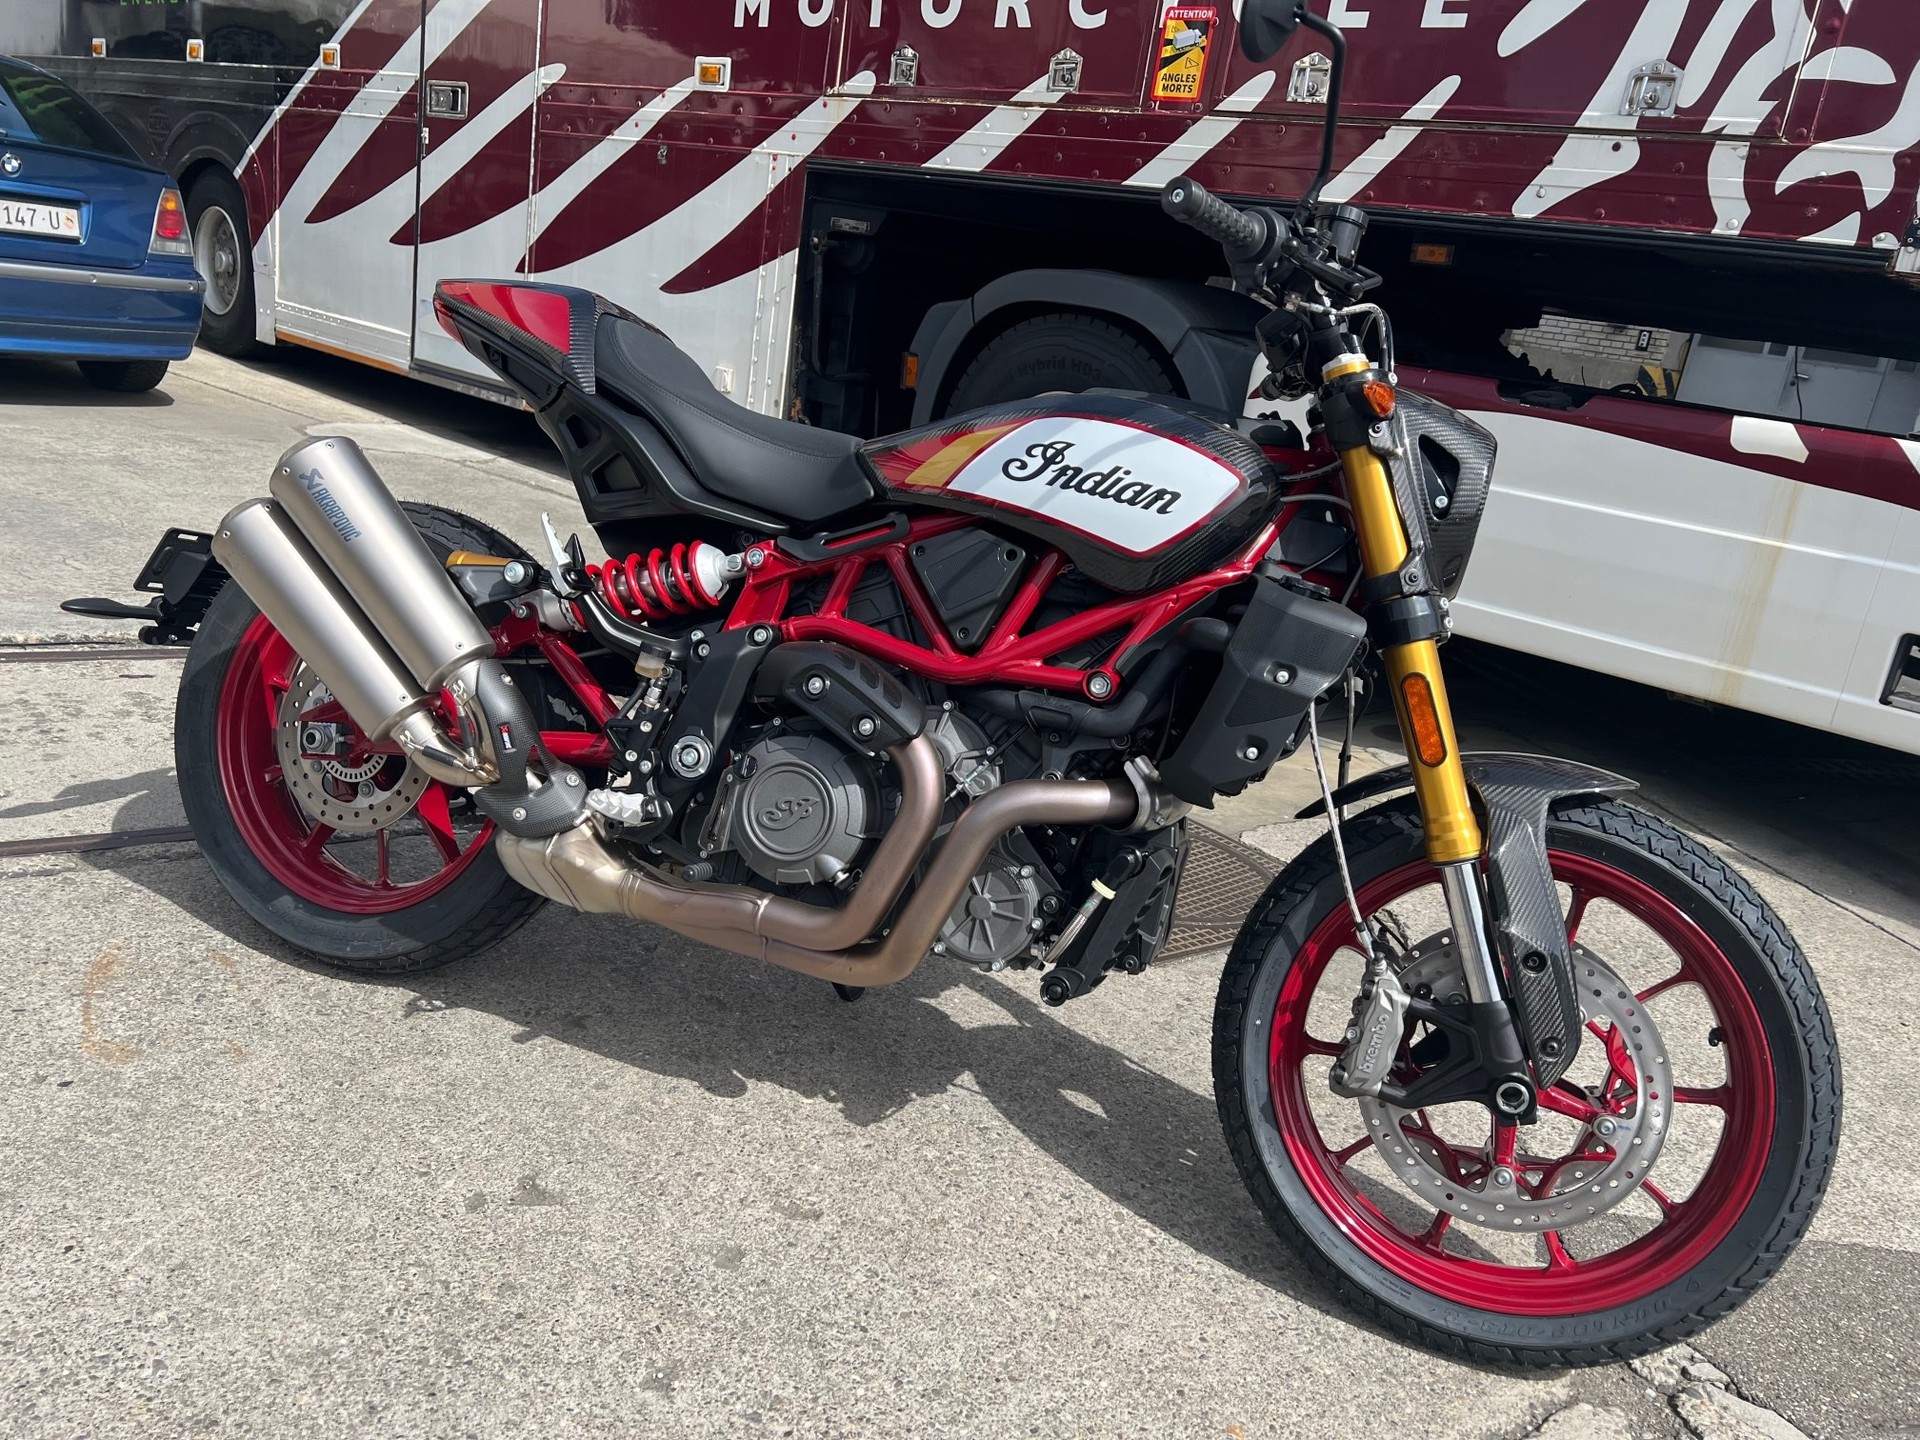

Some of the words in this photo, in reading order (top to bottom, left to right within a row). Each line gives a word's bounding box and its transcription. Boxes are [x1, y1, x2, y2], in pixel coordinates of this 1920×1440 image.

[1168, 9, 1213, 19] ATTENTION
[1161, 73, 1197, 84] ANGLES
[1161, 83, 1193, 94] MORTS
[1017, 355, 1066, 377] Hybrid
[1001, 440, 1182, 515] Indian
[1358, 1013, 1390, 1075] brembo
